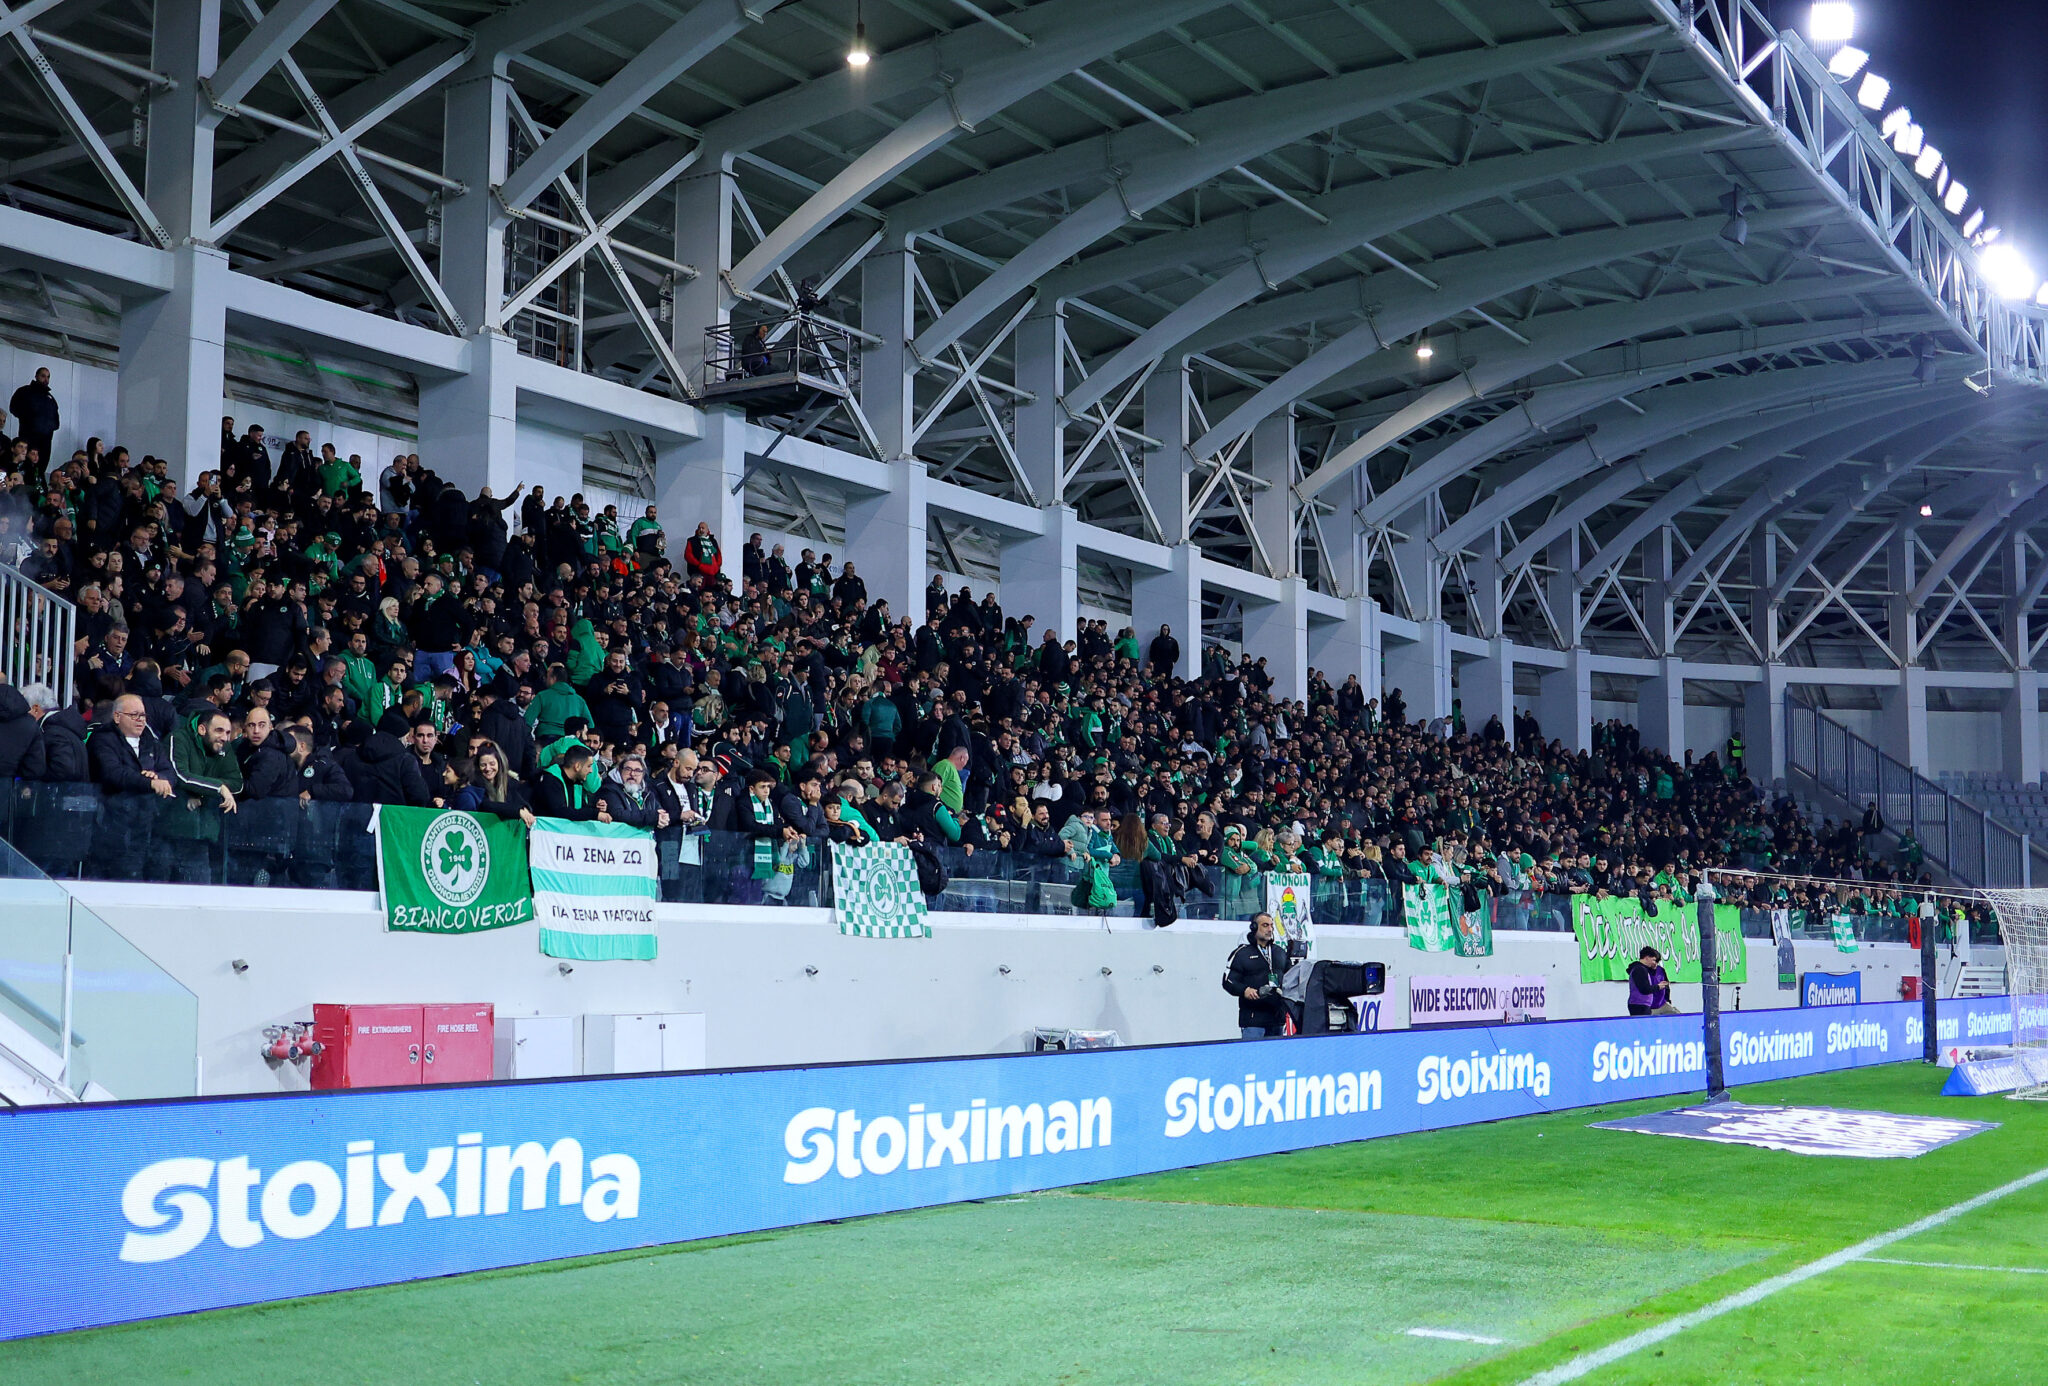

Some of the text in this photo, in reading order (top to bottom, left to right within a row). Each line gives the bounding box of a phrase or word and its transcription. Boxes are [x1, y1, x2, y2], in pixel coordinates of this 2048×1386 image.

[449, 855, 465, 863] 1948
[556, 845, 642, 864] ΓΙΑ ΣΕΝΑ ΖΩ
[552, 905, 569, 918] ΓΙΑ
[572, 908, 600, 922] ΣΕΝΑ
[1411, 986, 1545, 1012] WIDE SELECTION OF OFFERS
[358, 1025, 412, 1034] FIRE EXTINGUISHERS
[437, 1023, 479, 1033] FIRE HOSE REEL
[1827, 1019, 1888, 1054] Stoixima
[1967, 1011, 2011, 1038] Stoiximan
[1592, 1038, 1706, 1083] Stoiximan
[1729, 1029, 1814, 1067] Stoiximan
[1417, 1048, 1551, 1105] Stoixima
[1164, 1069, 1382, 1138] Stoiximan
[783, 1096, 1113, 1185] Stoiximan
[119, 1132, 641, 1263] Stoixima
